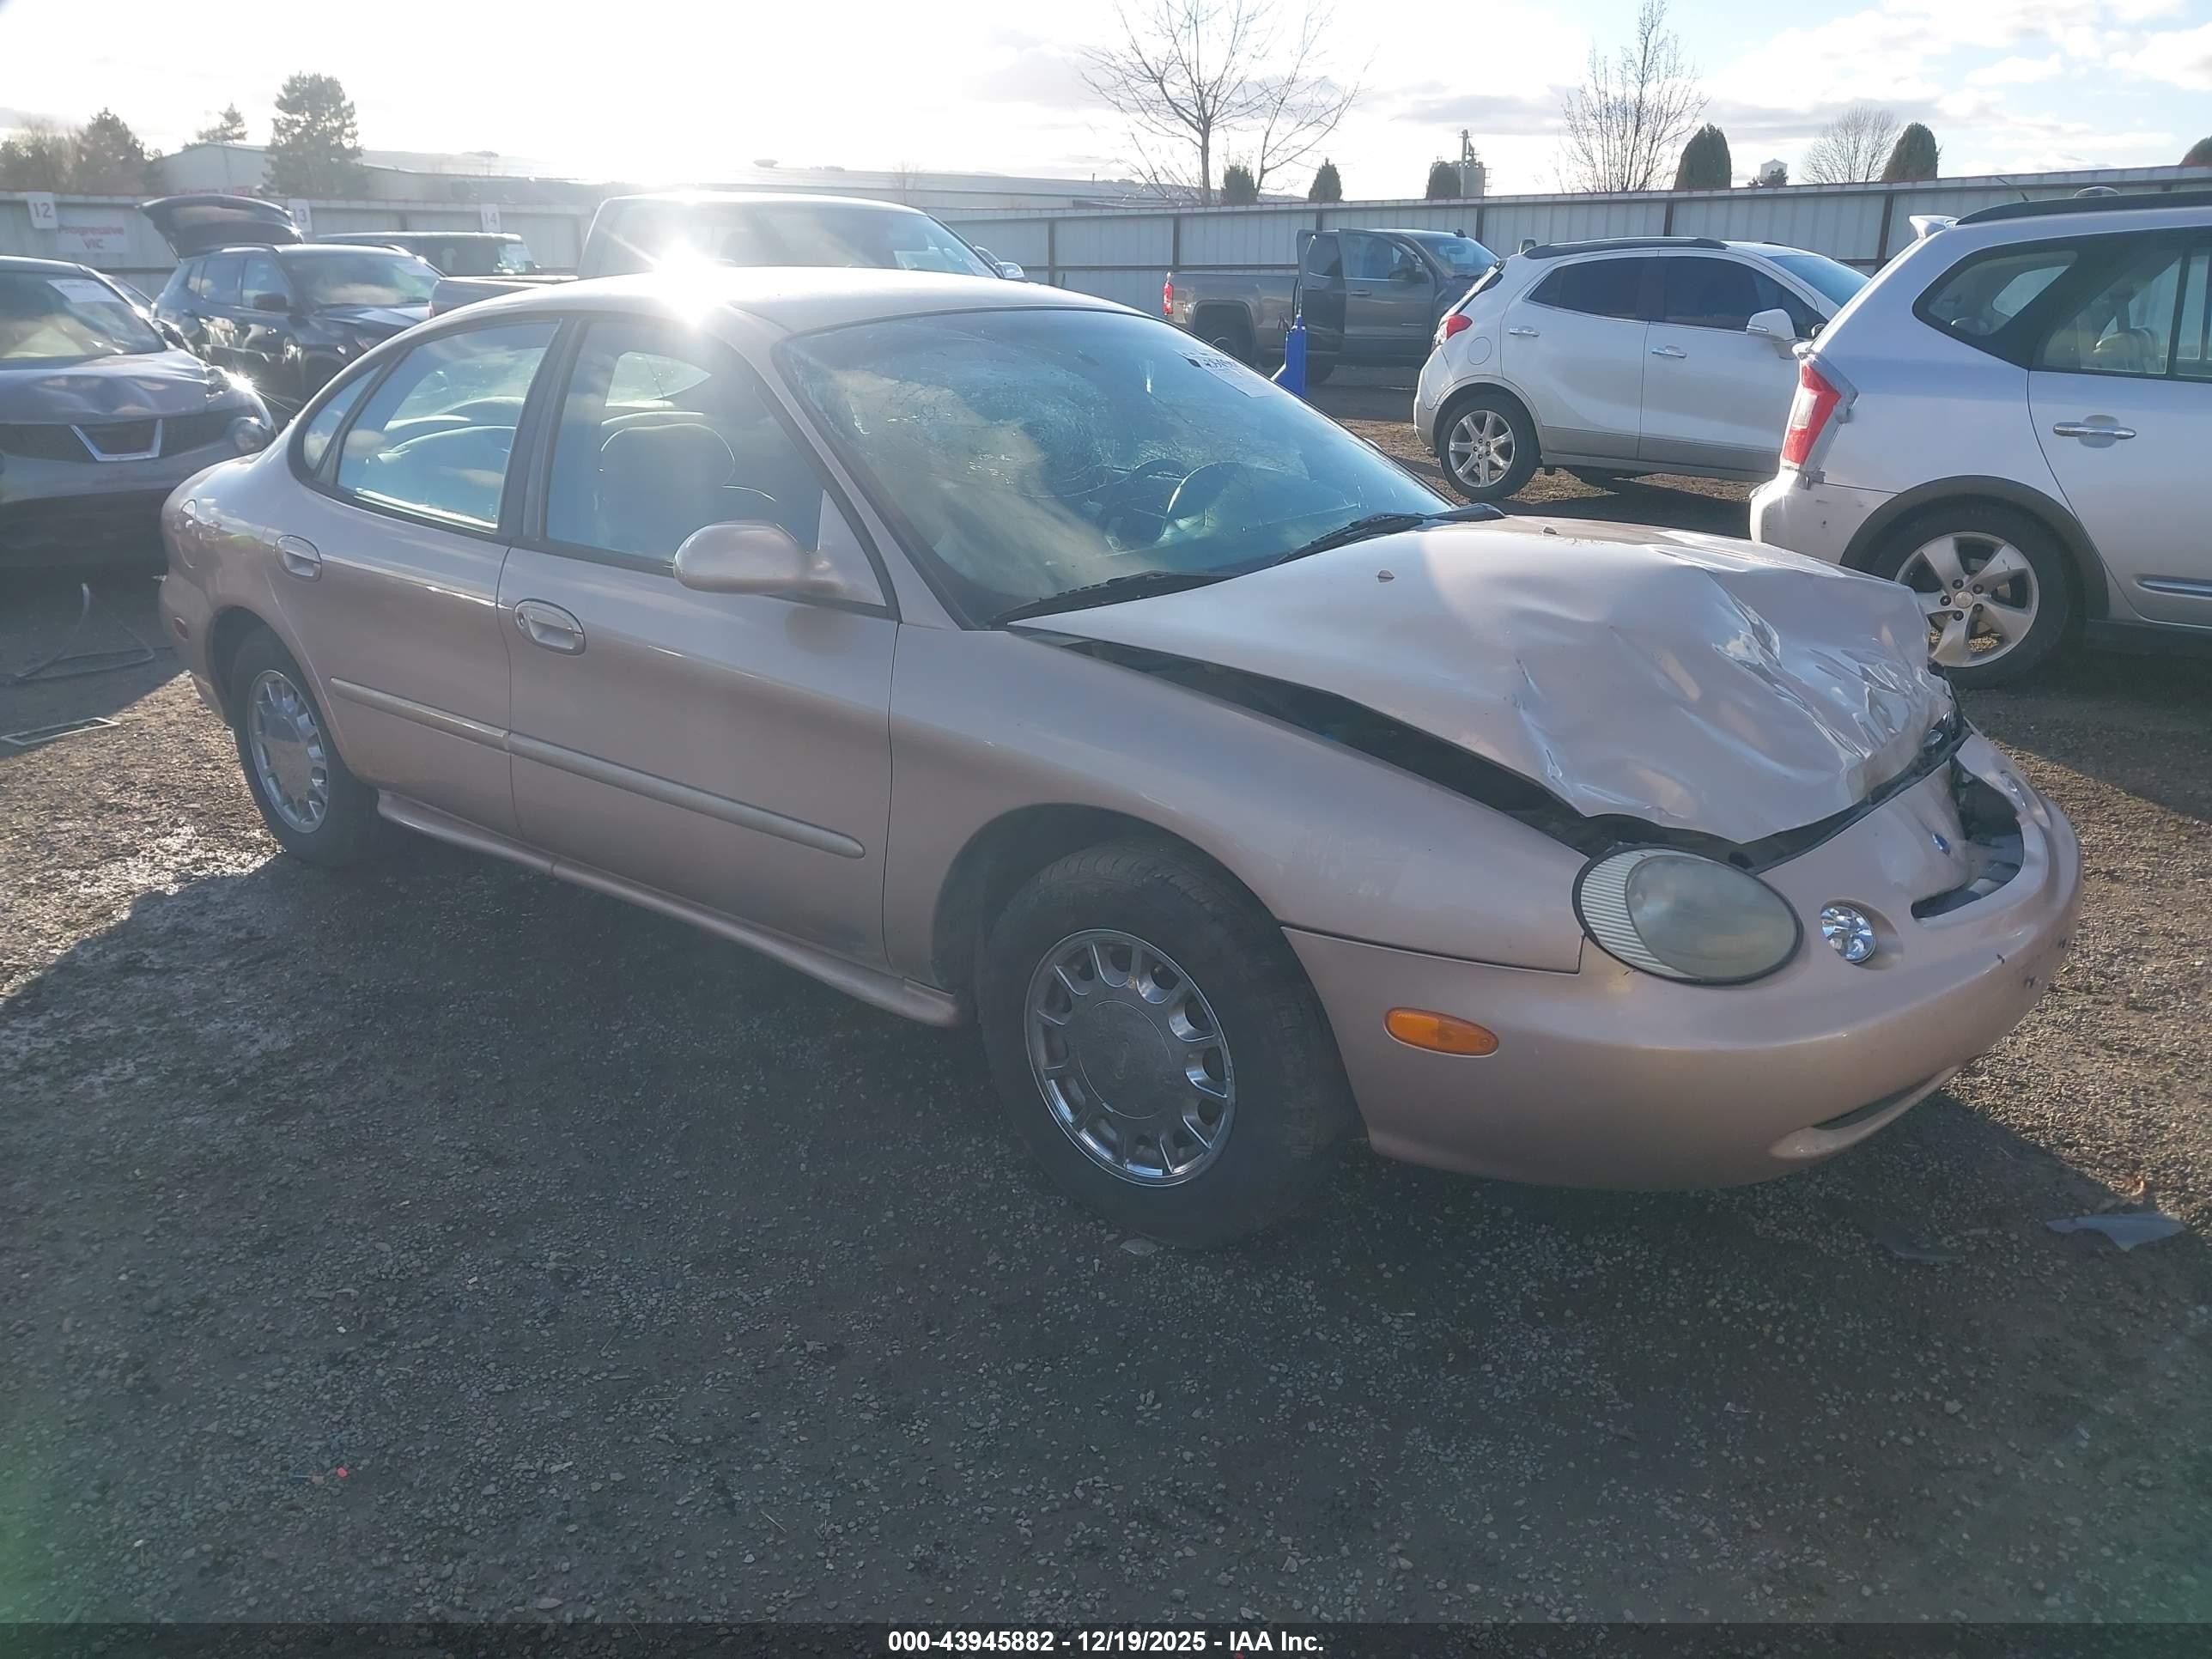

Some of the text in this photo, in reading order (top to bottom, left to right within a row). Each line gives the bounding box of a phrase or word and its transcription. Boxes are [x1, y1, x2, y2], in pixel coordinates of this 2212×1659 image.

[34, 203, 52, 218] 12
[483, 212, 496, 225] 14
[58, 225, 125, 236] Progressive
[84, 240, 104, 249] VIC
